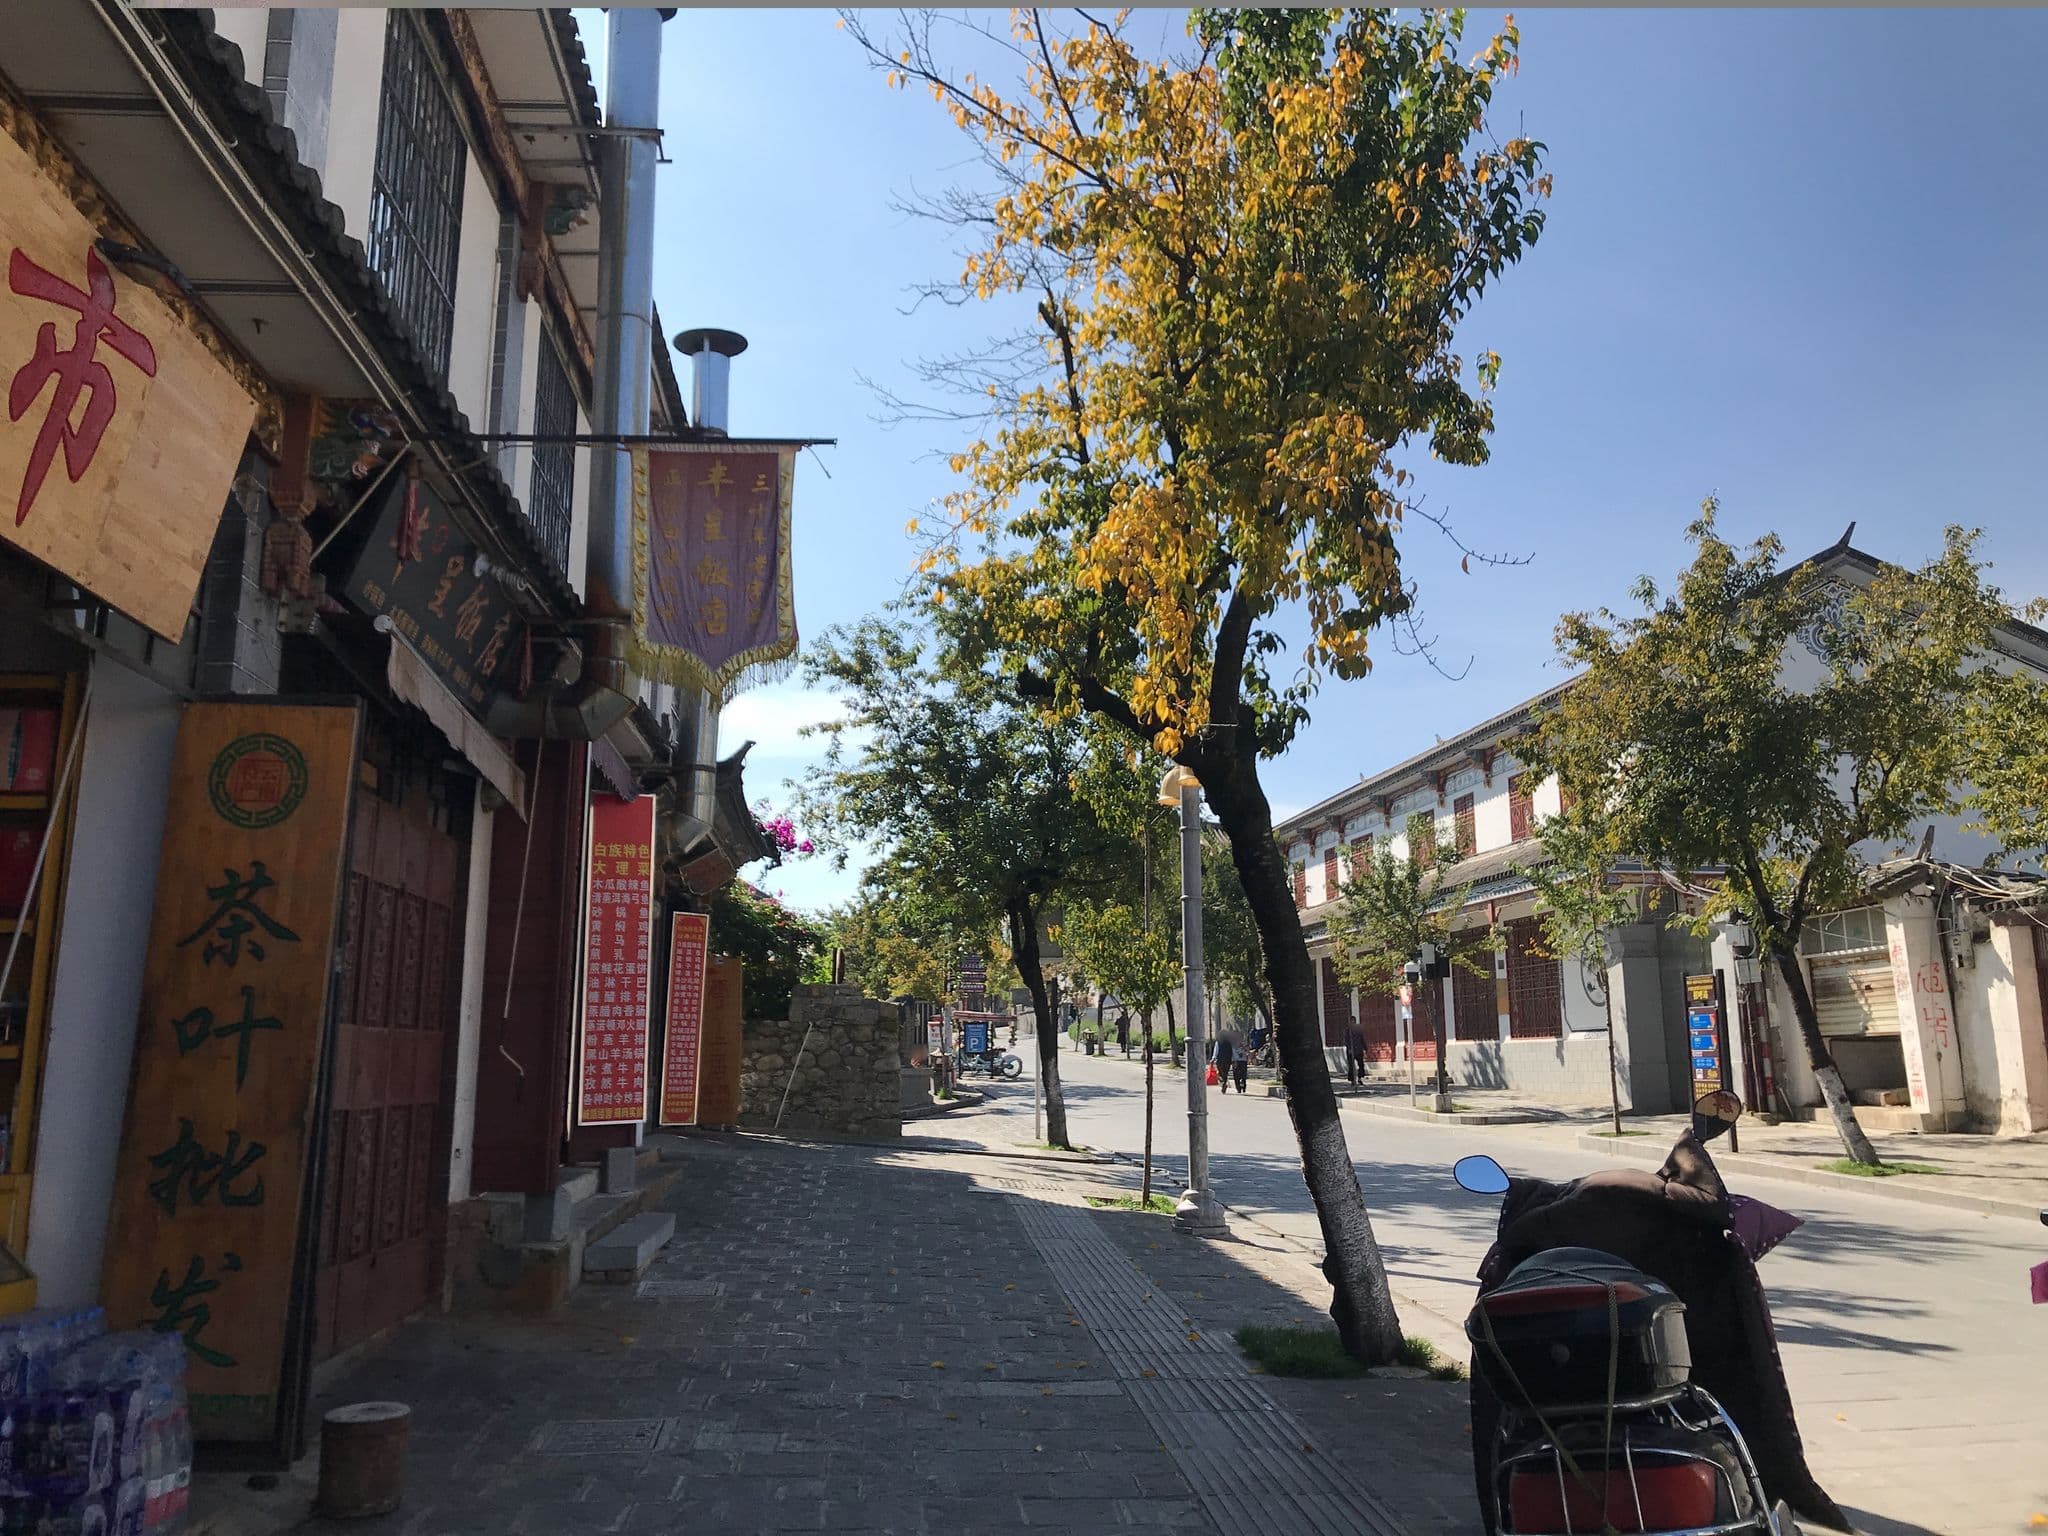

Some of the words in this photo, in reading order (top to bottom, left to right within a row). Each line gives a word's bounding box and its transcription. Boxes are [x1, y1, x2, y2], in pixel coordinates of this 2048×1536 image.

[594, 843, 650, 858] 白族特色
[593, 861, 650, 876] 大理菜
[593, 879, 649, 891] 木瓜酸辣鱼
[585, 1062, 644, 1074] 水煮牛肉
[585, 1077, 644, 1089] 孜然牛肉
[149, 861, 301, 1367] 茶叶批发
